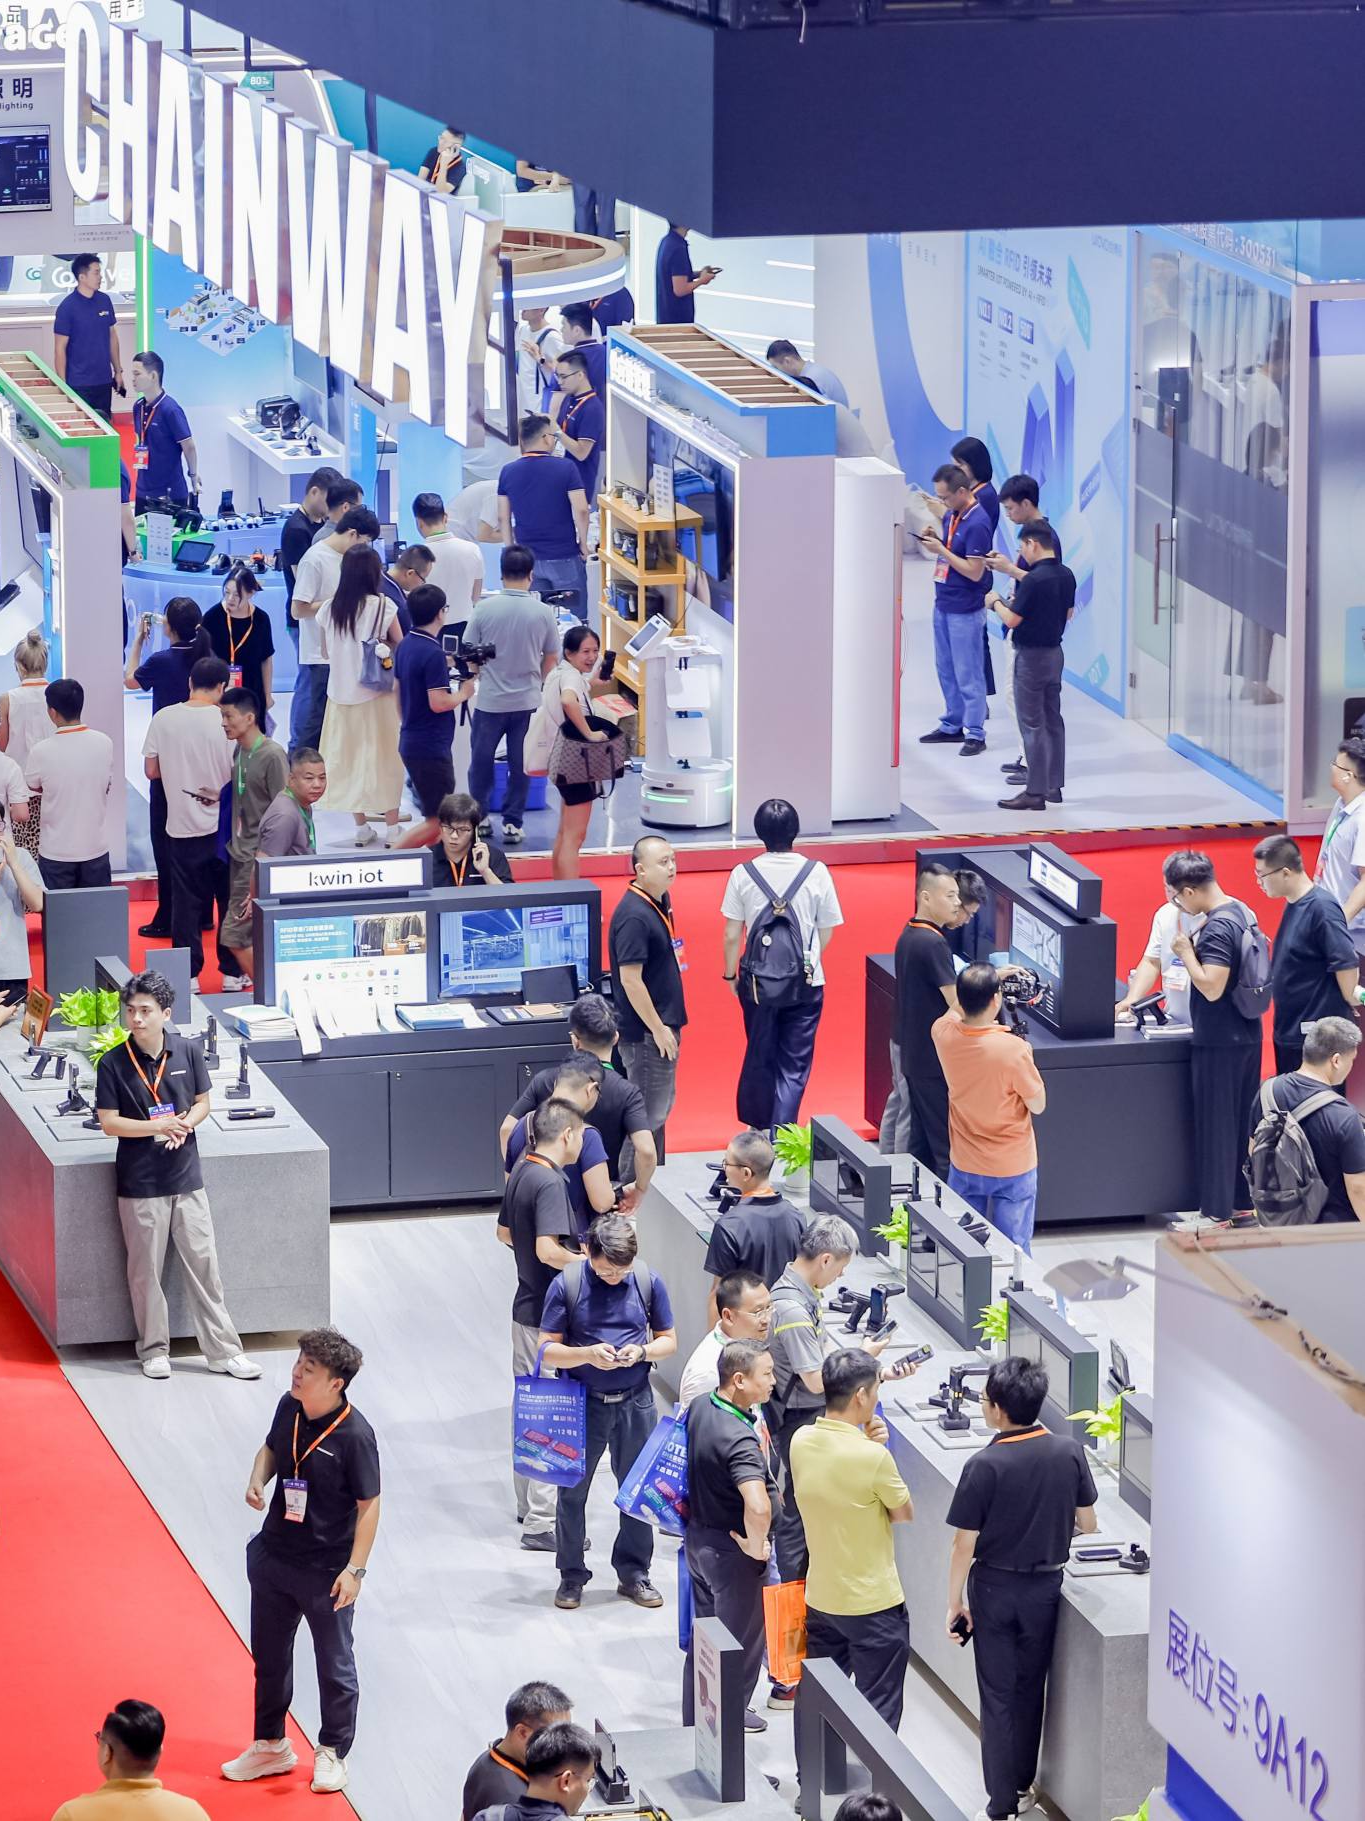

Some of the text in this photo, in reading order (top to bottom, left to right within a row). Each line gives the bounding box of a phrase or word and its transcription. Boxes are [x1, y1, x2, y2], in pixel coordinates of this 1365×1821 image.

[0, 101, 34, 111] lighting
[64, 0, 501, 447] CHAINWAY
[308, 868, 384, 887] kwin iot
[1166, 1607, 1329, 1821] 展位号:9A12
